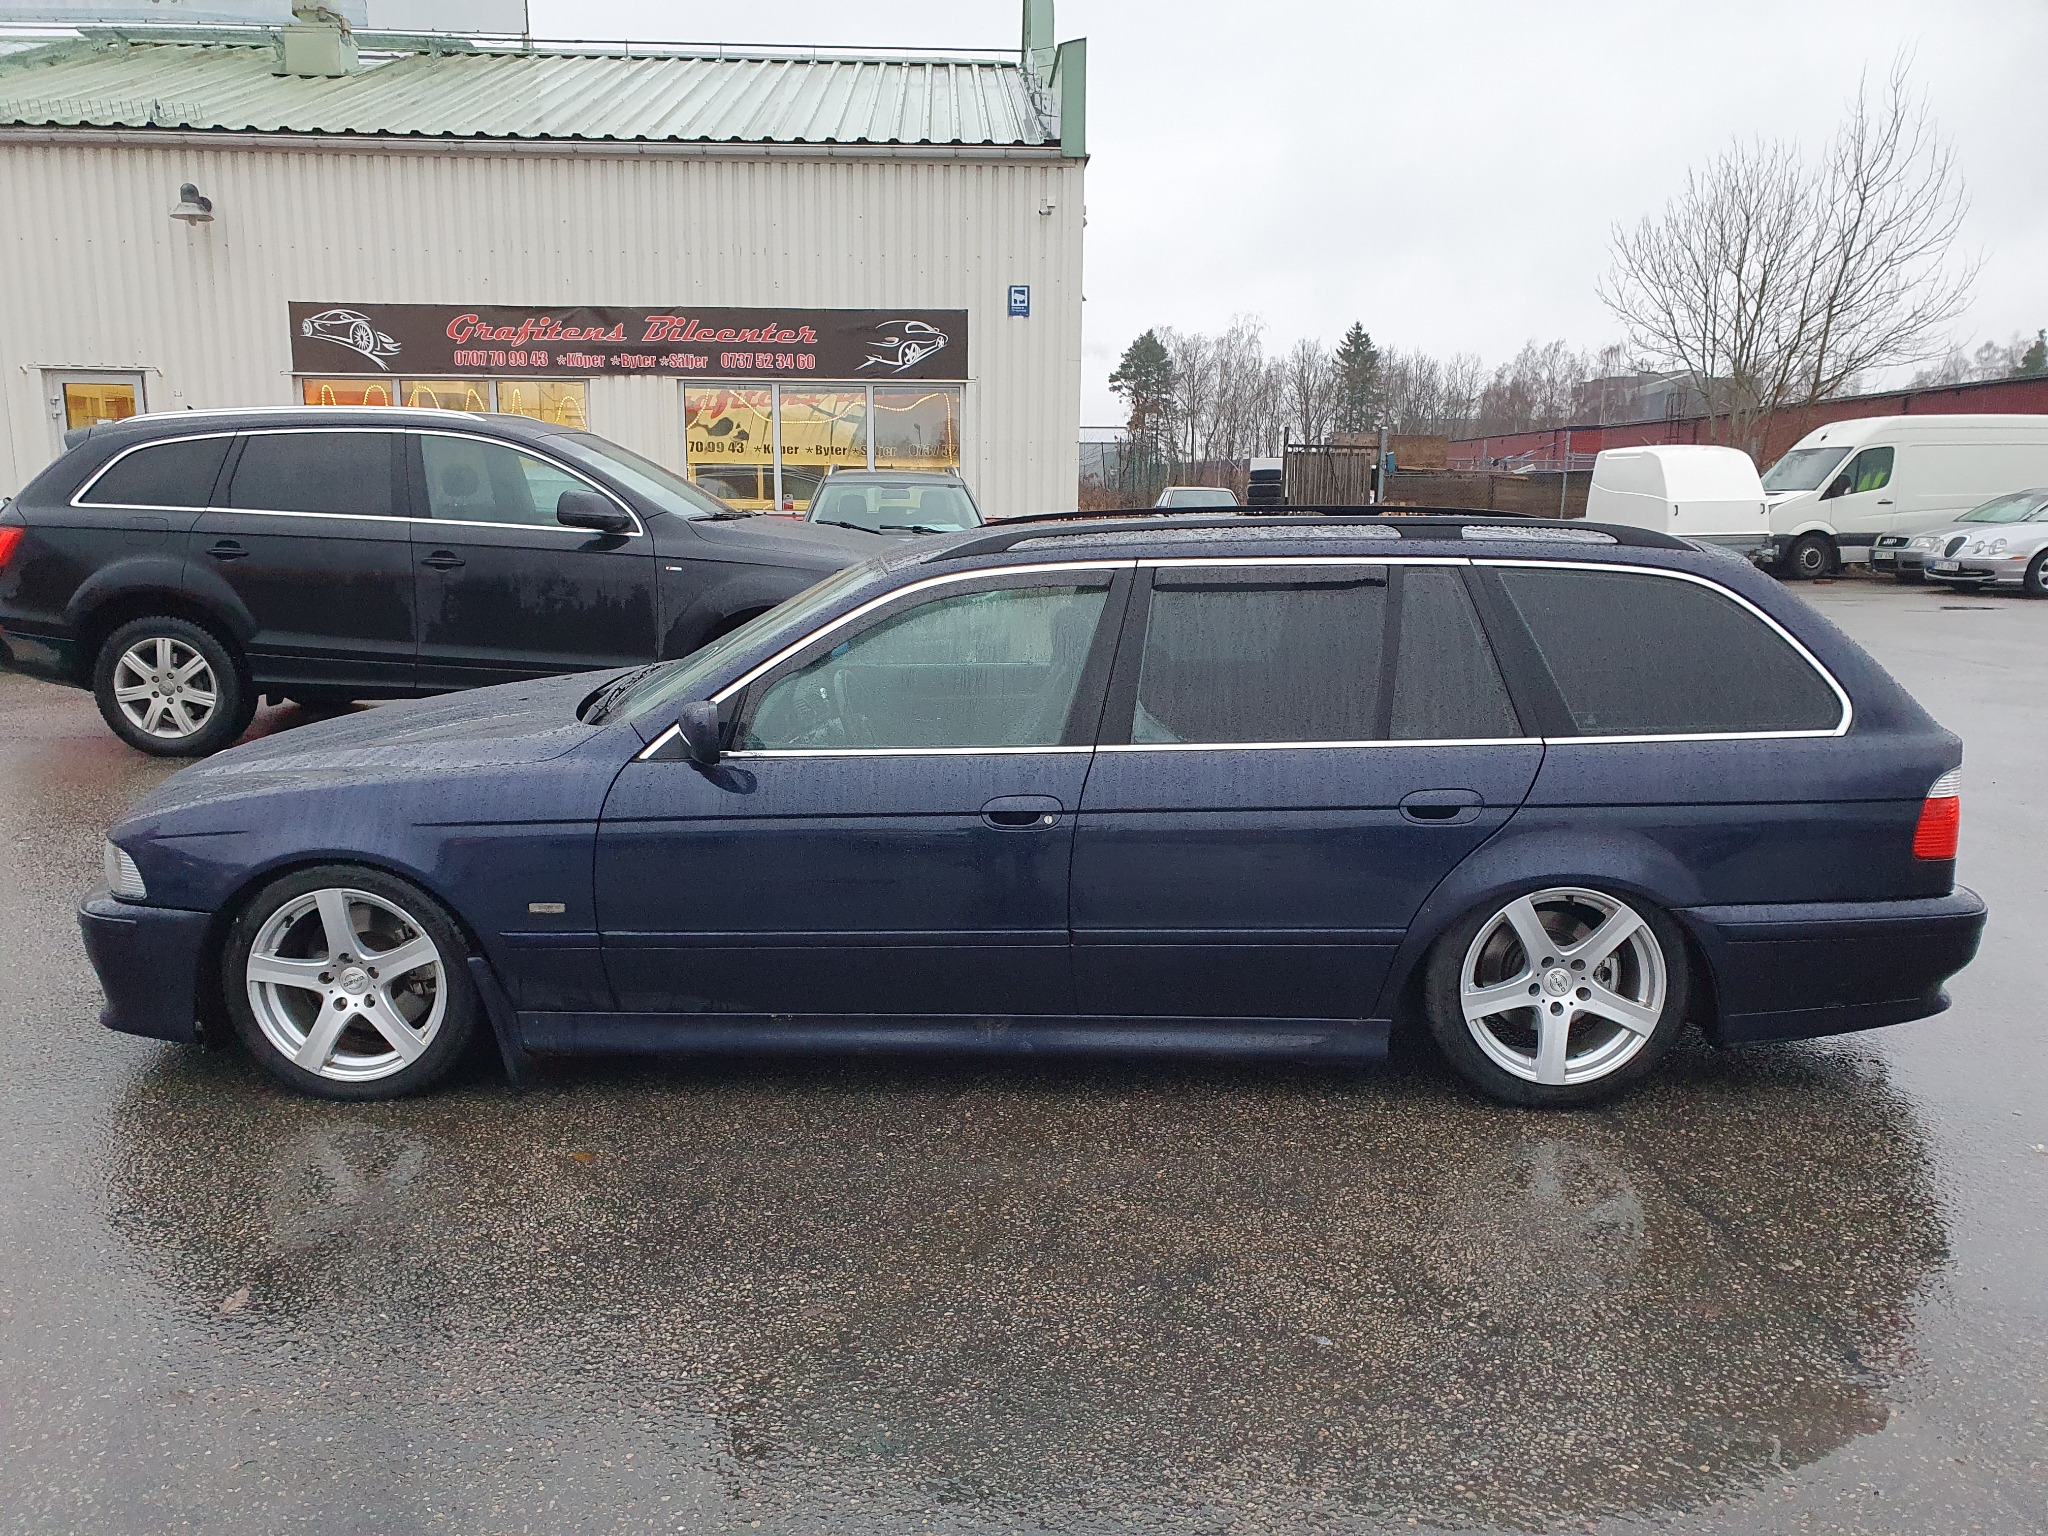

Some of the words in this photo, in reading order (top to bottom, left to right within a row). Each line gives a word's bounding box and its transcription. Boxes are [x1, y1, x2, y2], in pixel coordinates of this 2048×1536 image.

[446, 313, 628, 347] Grafitens
[641, 315, 819, 344] Bilcenter
[454, 350, 487, 367] 0707
[489, 351, 506, 367] 70
[508, 351, 528, 367] 99
[530, 352, 548, 367] 43
[721, 353, 754, 368] 0737
[755, 354, 774, 369] 52
[776, 354, 795, 369] 34
[797, 354, 816, 370] 60
[689, 440, 704, 454] 70
[707, 441, 725, 454] 99
[728, 441, 745, 454] 43
